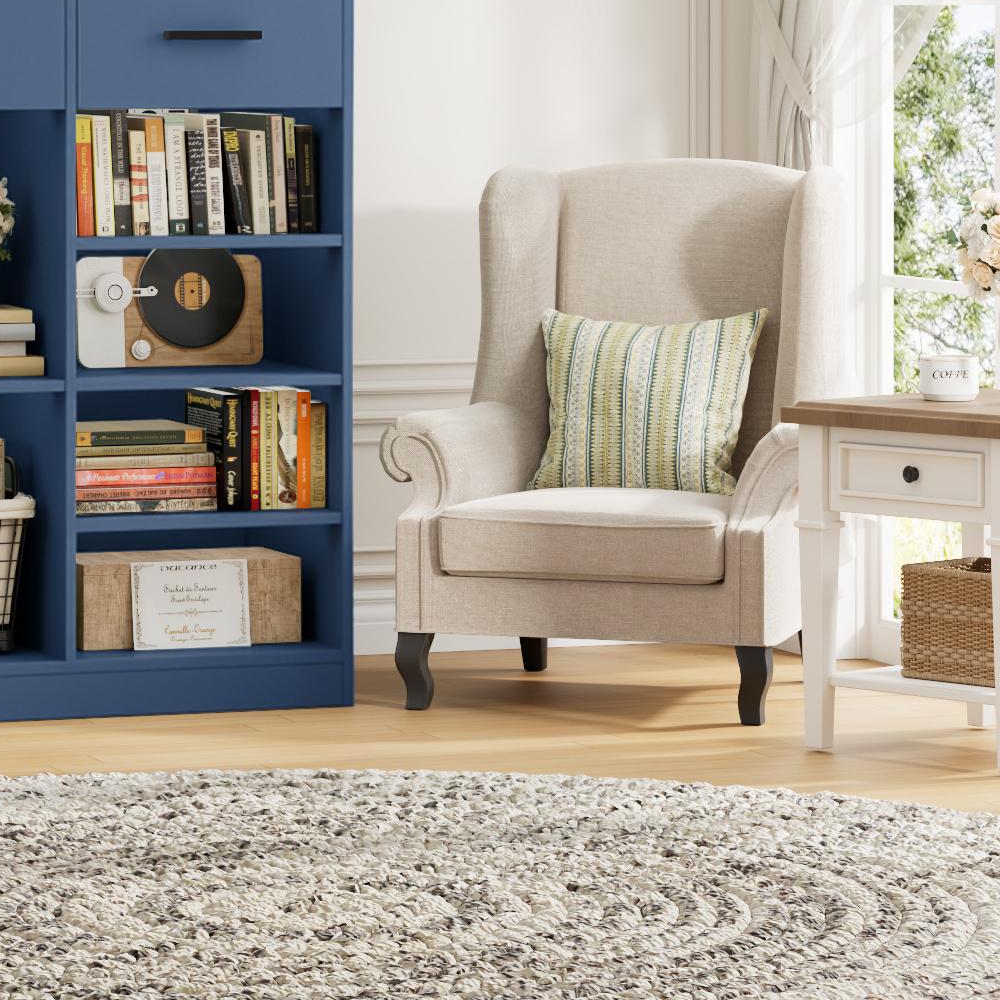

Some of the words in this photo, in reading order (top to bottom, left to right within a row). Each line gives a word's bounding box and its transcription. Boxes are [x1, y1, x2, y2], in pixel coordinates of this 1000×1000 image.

[173, 135, 180, 145] AM
[224, 131, 239, 151] IMPRO
[226, 399, 238, 430] HEMINGWAY
[226, 431, 238, 448] QUEST
[194, 624, 216, 636] Orange
